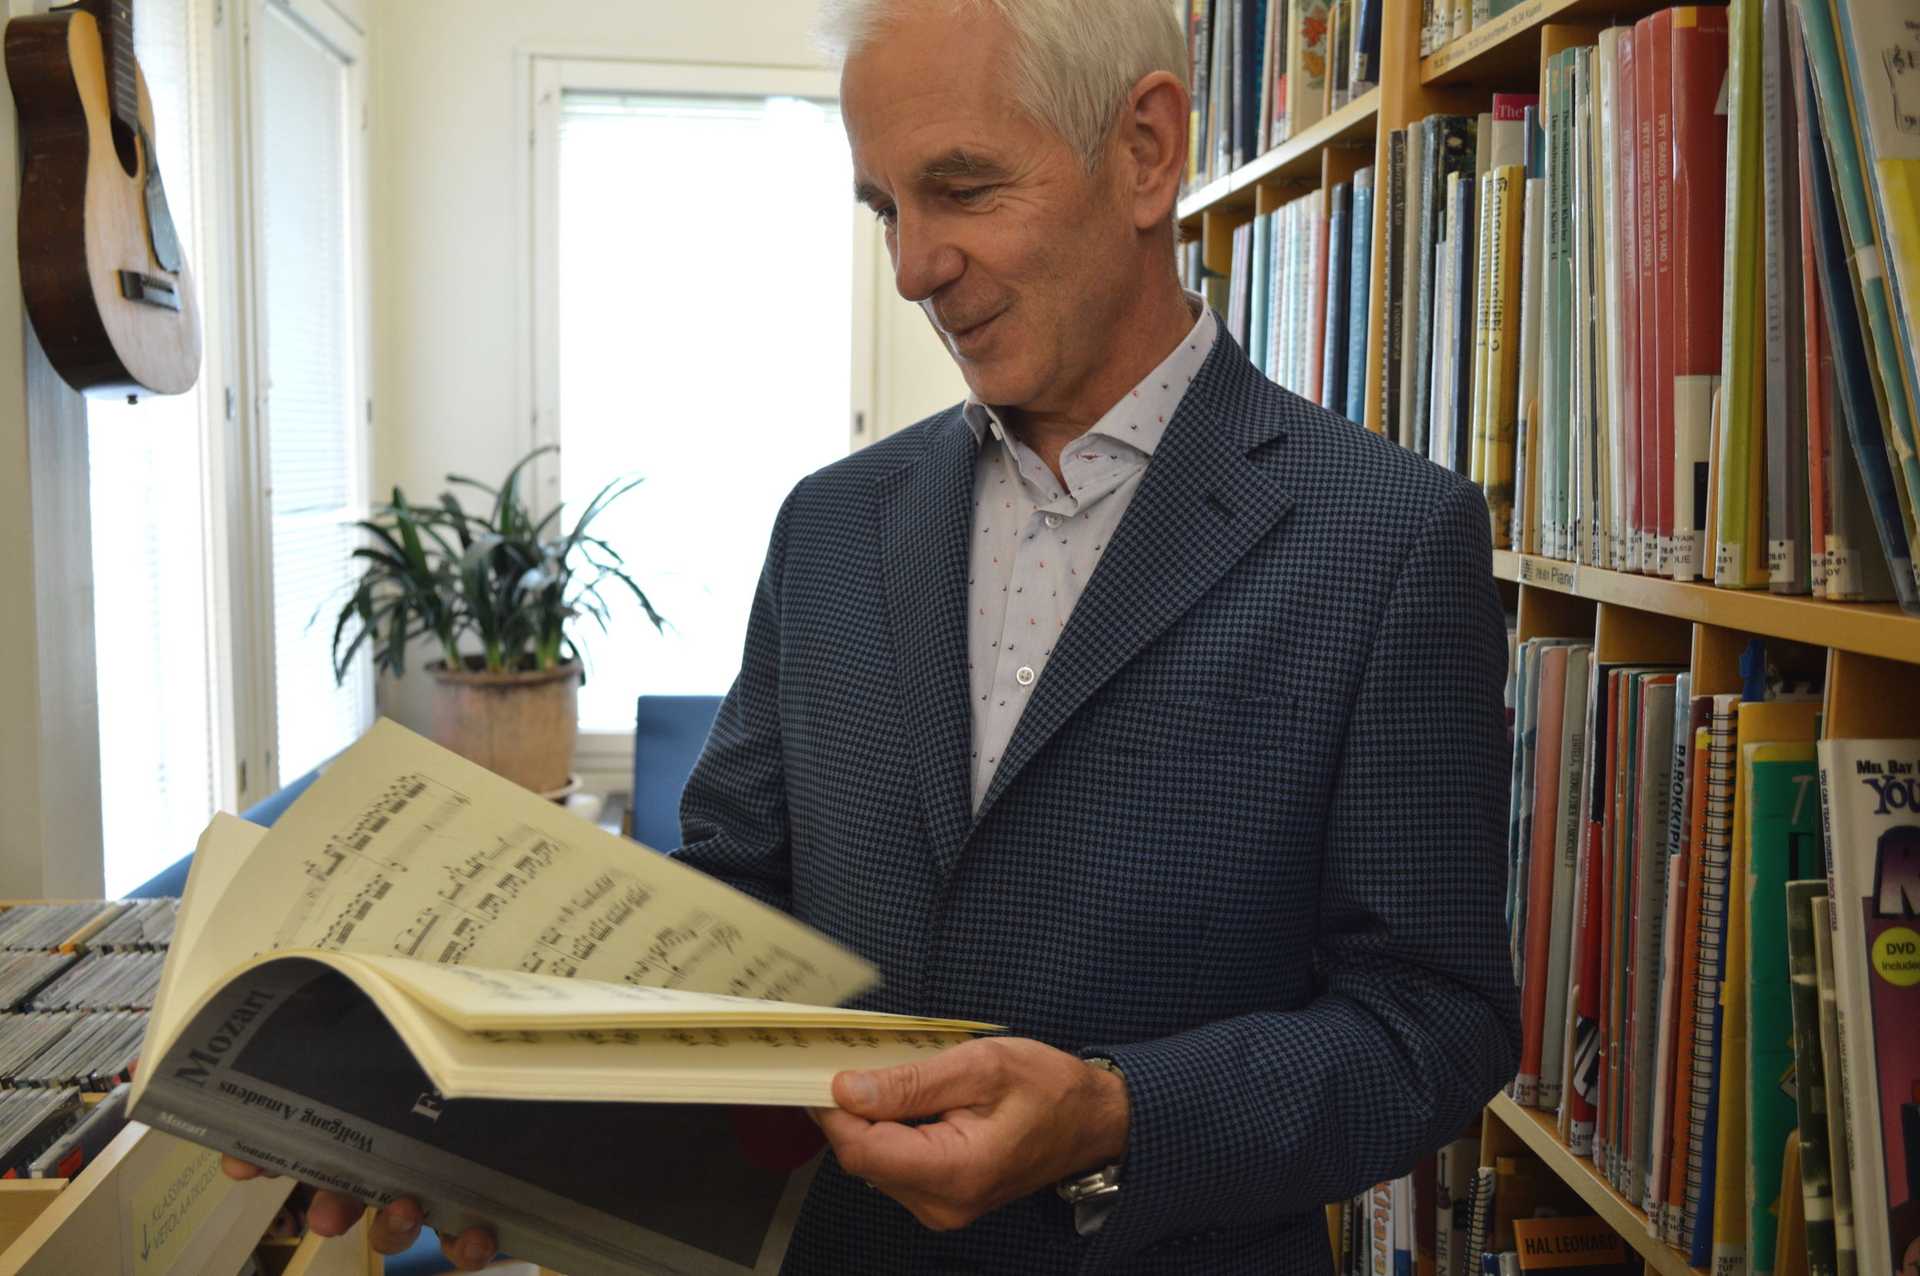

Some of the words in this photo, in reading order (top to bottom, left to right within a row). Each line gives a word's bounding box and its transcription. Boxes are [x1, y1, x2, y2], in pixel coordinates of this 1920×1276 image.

[1658, 213, 1668, 231] FOR
[1642, 239, 1651, 266] PIANO
[1658, 233, 1668, 262] PIANO
[1551, 566, 1574, 587] Piano
[1856, 760, 1883, 774] MEL
[1888, 760, 1912, 774] BAY
[1823, 806, 1832, 833] TEACH
[1825, 834, 1834, 874] YOURSELF
[1830, 901, 1838, 931] GUITAR
[1886, 942, 1917, 956] DVD
[175, 987, 274, 1088] Mozart
[217, 1080, 300, 1121] Amadeus
[156, 1110, 208, 1137] Mozart
[299, 1107, 377, 1154] Wolfgang
[234, 1139, 290, 1169] Sonaten,
[291, 1160, 353, 1191] Fantasien
[352, 1182, 378, 1202] und
[1525, 1236, 1552, 1256] HAL
[1555, 1232, 1617, 1254] LEONARD
